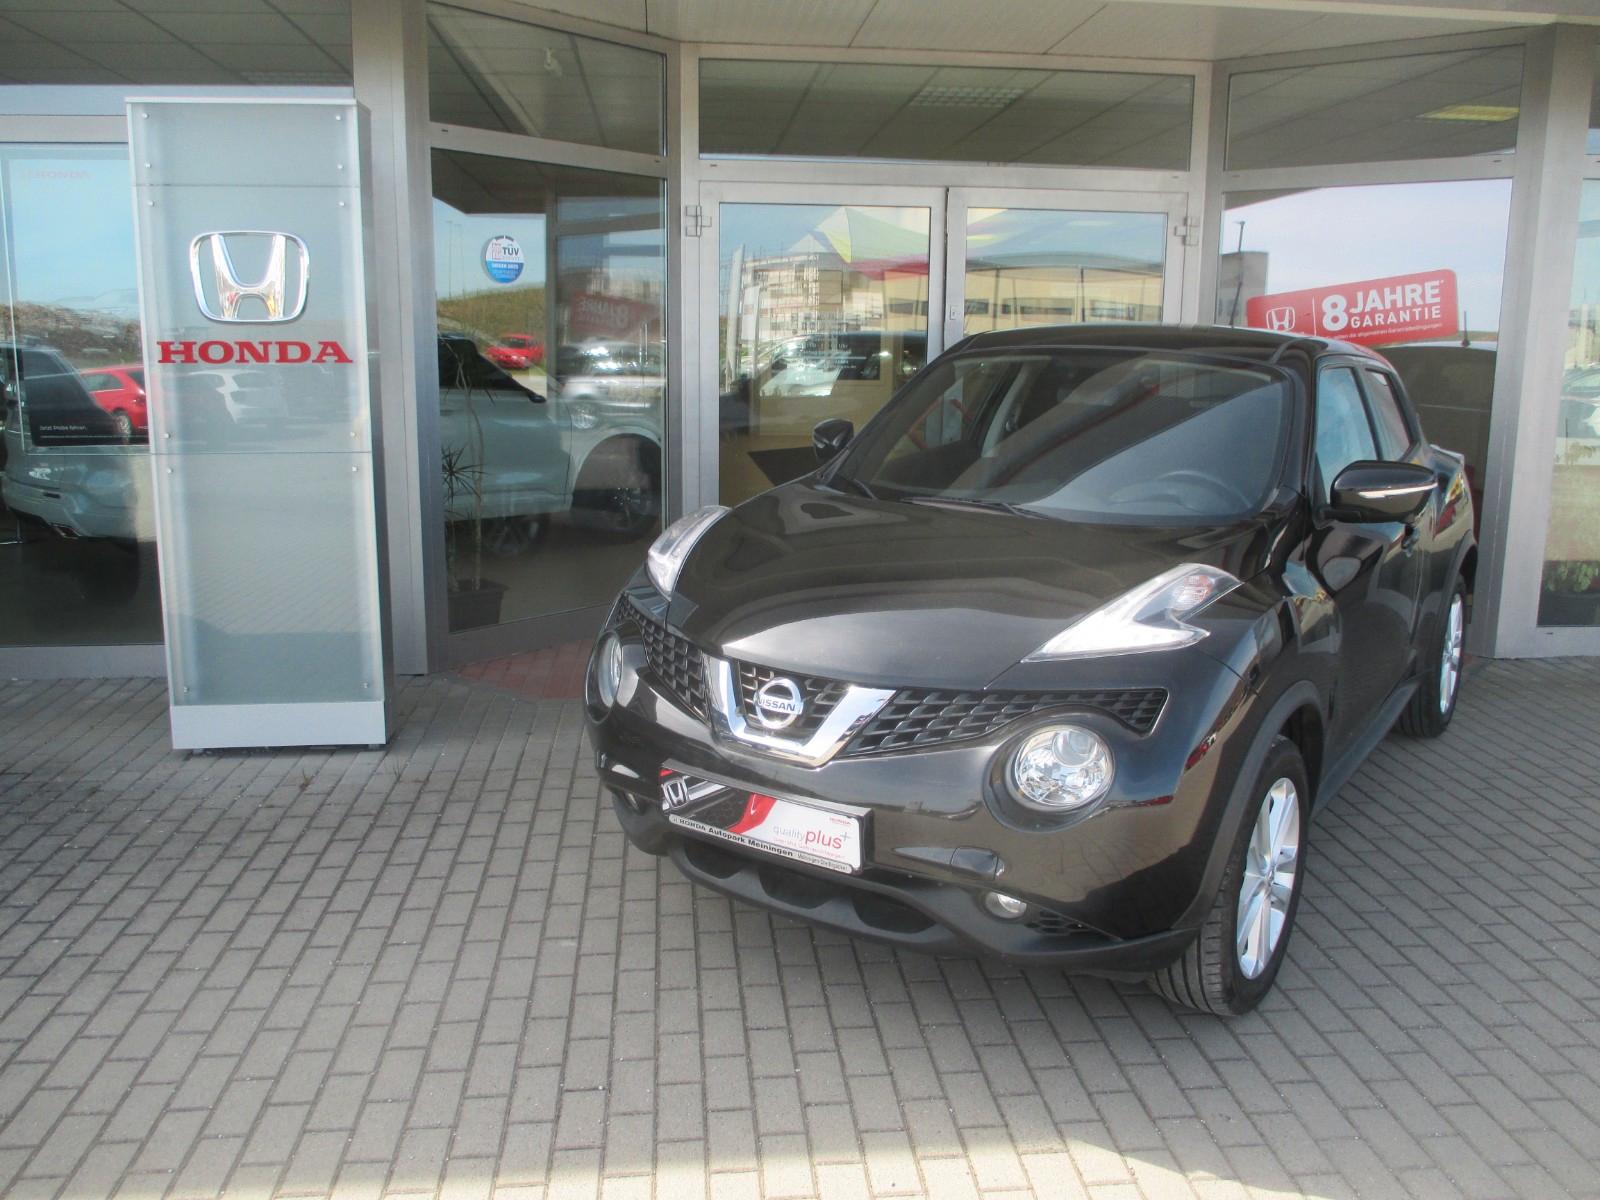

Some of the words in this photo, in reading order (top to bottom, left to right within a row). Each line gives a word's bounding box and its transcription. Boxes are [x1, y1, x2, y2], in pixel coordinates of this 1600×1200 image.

[1321, 294, 1349, 332] 8
[1350, 280, 1441, 314] JAHRE
[1350, 305, 1441, 329] GARANTIE
[156, 340, 353, 364] HONDA
[758, 698, 796, 712] NISSAN
[708, 827, 746, 844] Autopark
[748, 839, 794, 857] Meiningen
[773, 824, 806, 841] quality
